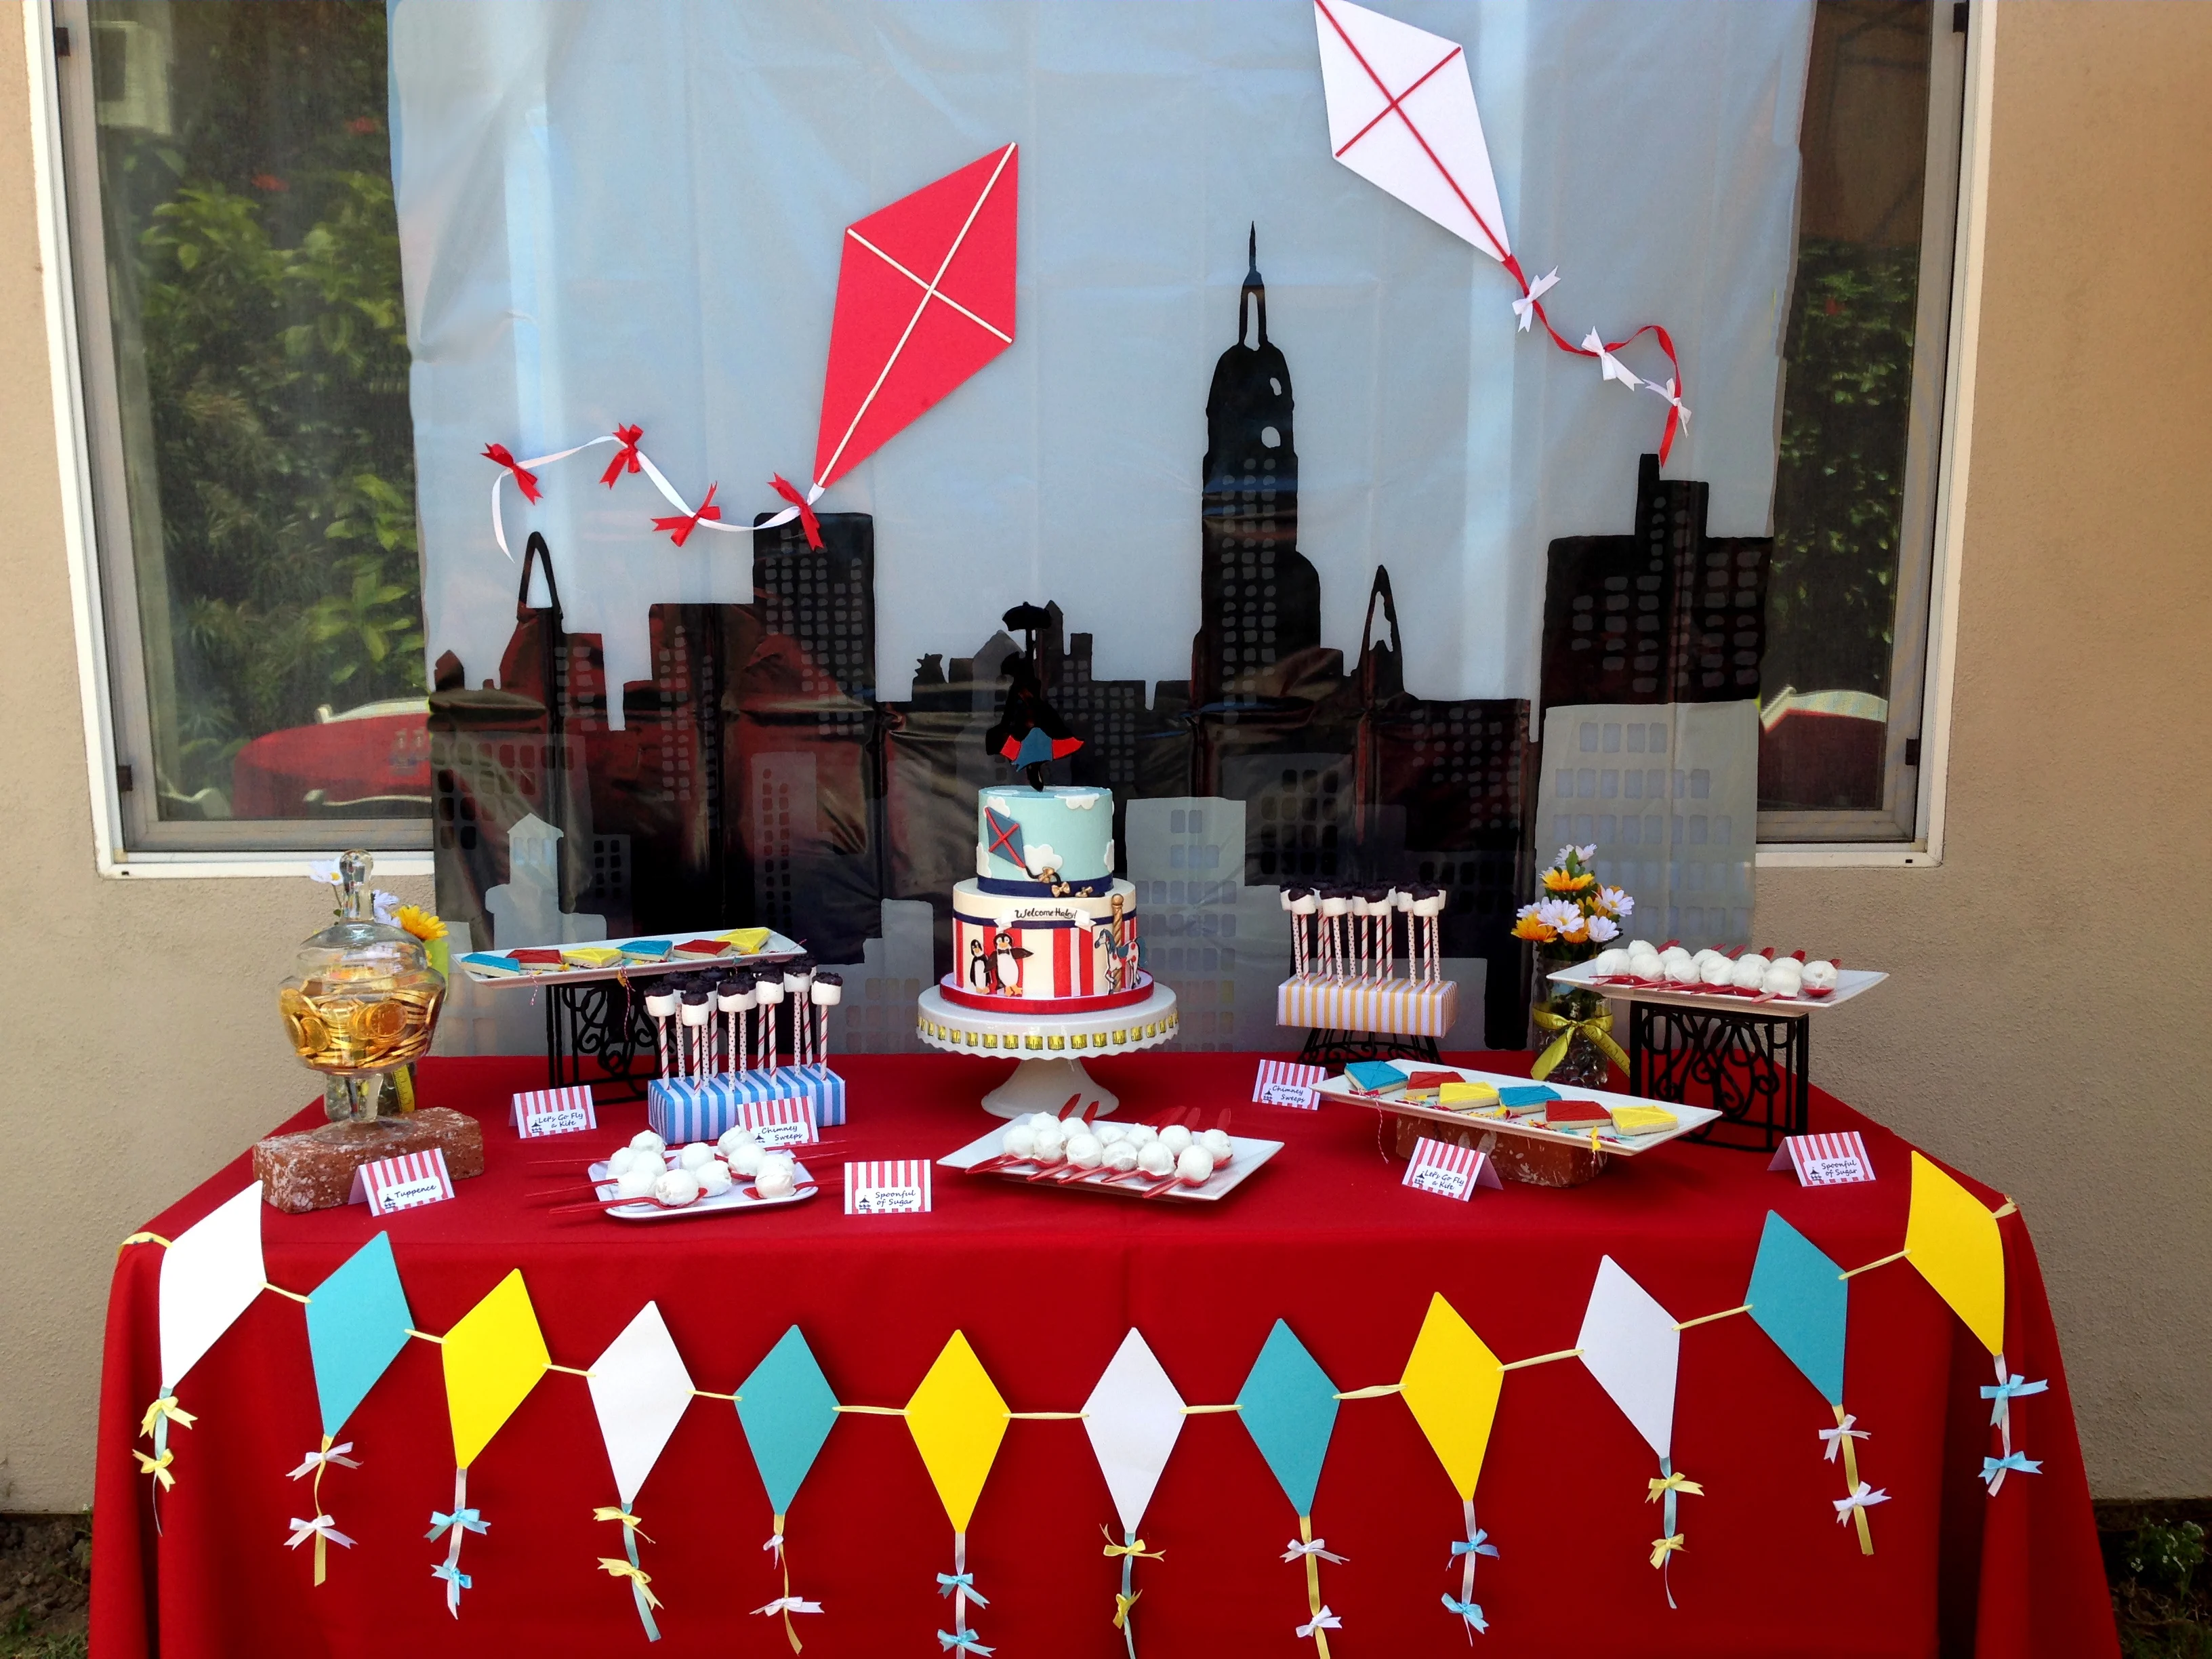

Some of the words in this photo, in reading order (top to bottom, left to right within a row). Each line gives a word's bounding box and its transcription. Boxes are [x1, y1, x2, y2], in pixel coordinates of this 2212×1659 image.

[1015, 907, 1054, 919] Welcome
[1272, 1085, 1304, 1096] Chimney
[1280, 1094, 1306, 1103] Sweeps
[538, 1115, 556, 1124] Let's
[761, 1125, 798, 1134] Chimney
[775, 1133, 803, 1141] Sweeps
[1821, 1160, 1858, 1170] Spoonful
[1825, 1170, 1834, 1178] of
[1836, 1168, 1858, 1176] Sugar
[1424, 1170, 1440, 1179] Let's
[1452, 1176, 1465, 1187] Fly
[1439, 1181, 1455, 1190] Kite
[394, 1185, 437, 1198] Tuppence
[875, 1190, 916, 1200] Spoonful
[876, 1199, 886, 1208] of
[888, 1198, 914, 1207] Sugar
